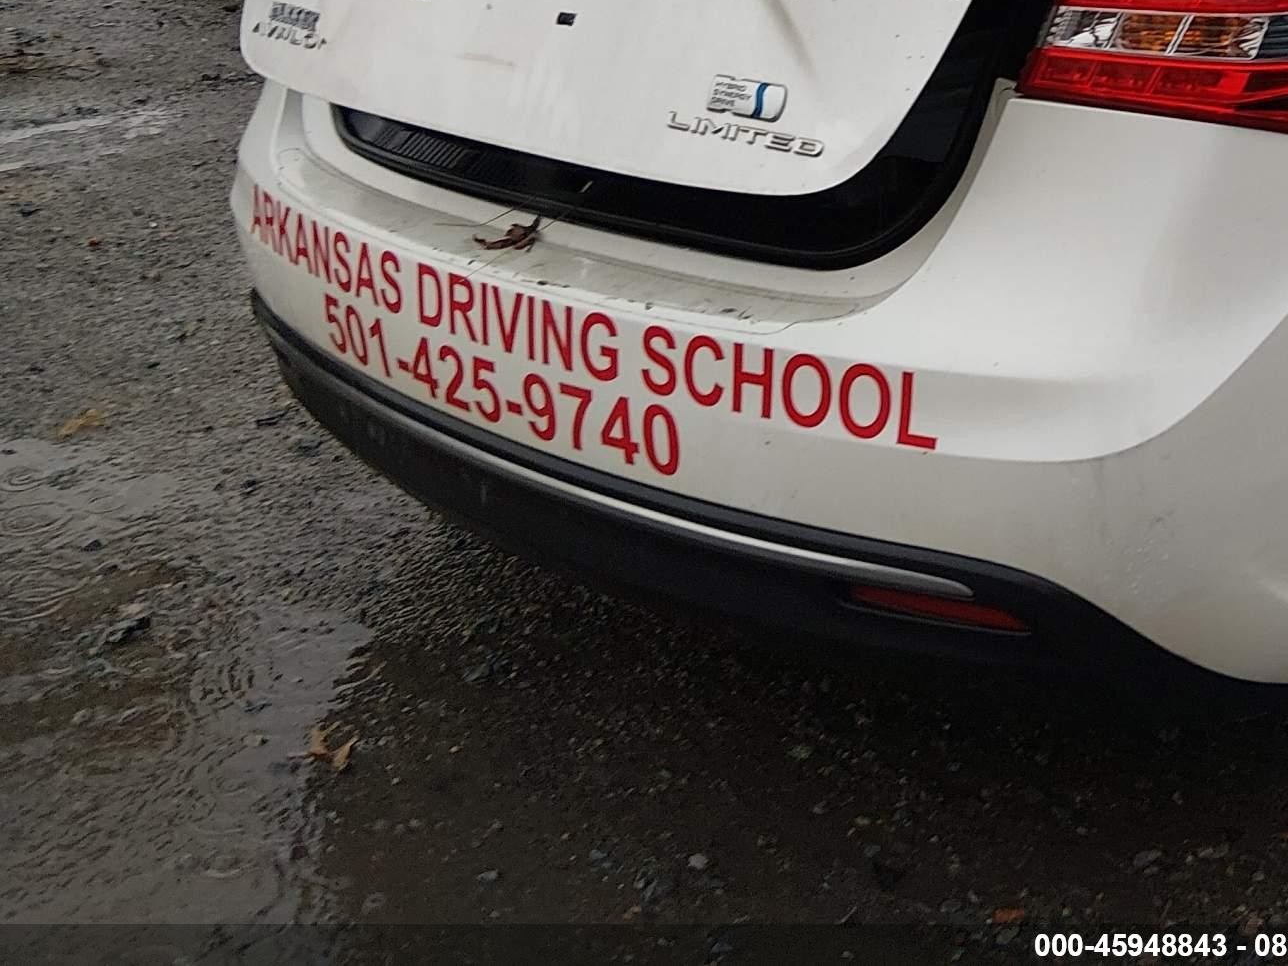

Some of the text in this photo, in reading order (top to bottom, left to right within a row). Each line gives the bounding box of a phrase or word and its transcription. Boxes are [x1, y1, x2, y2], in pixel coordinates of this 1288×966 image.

[667, 110, 825, 159] LIMITED
[252, 184, 938, 451] ARKANSAS DRIVING SCHOOL
[324, 293, 681, 476] 501-425-9740
